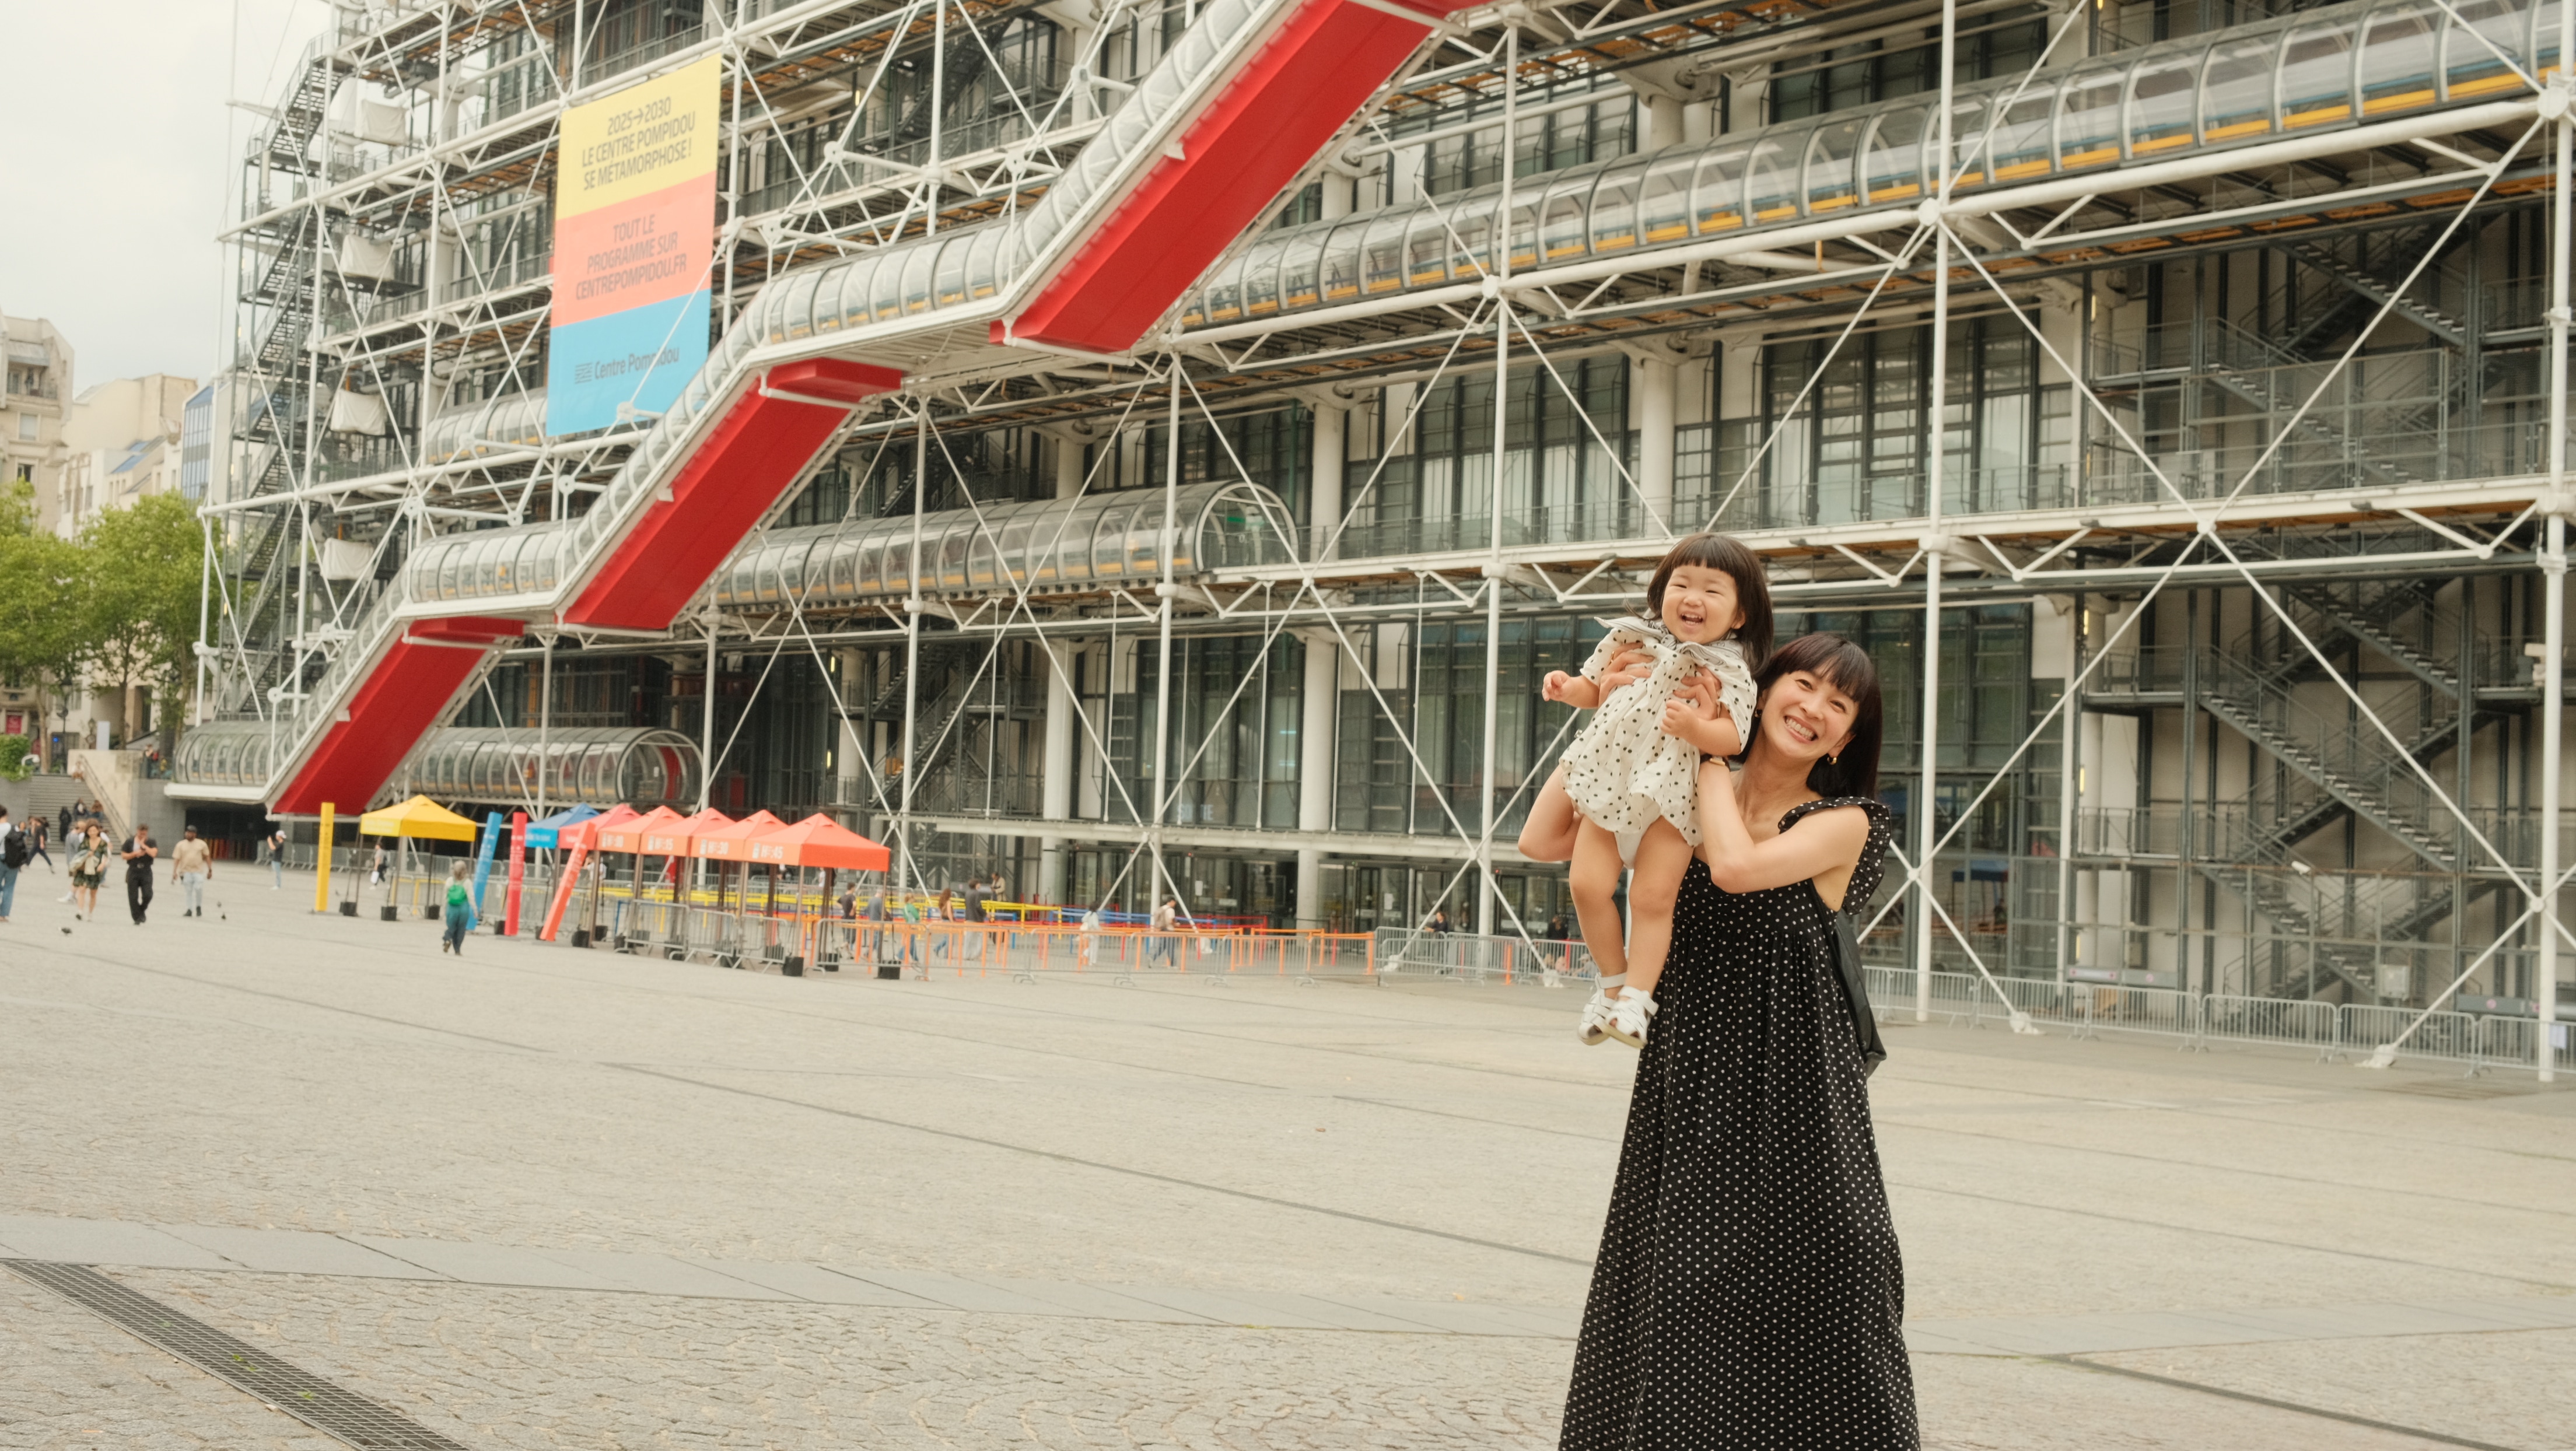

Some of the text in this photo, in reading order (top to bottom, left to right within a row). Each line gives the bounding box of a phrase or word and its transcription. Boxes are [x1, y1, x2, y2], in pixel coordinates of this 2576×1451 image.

[582, 111, 695, 167] LE CENTRE POMPIDOU
[584, 170, 596, 191] SE
[598, 139, 687, 187] MÉTAMORPHOSE
[614, 214, 655, 243] TOUT LE
[587, 231, 678, 275] PROGRAMME SUR
[576, 253, 687, 300] CENTREPOMPIDOU.FR
[594, 360, 626, 379] Centre
[1177, 804, 1214, 822] SOTIE
